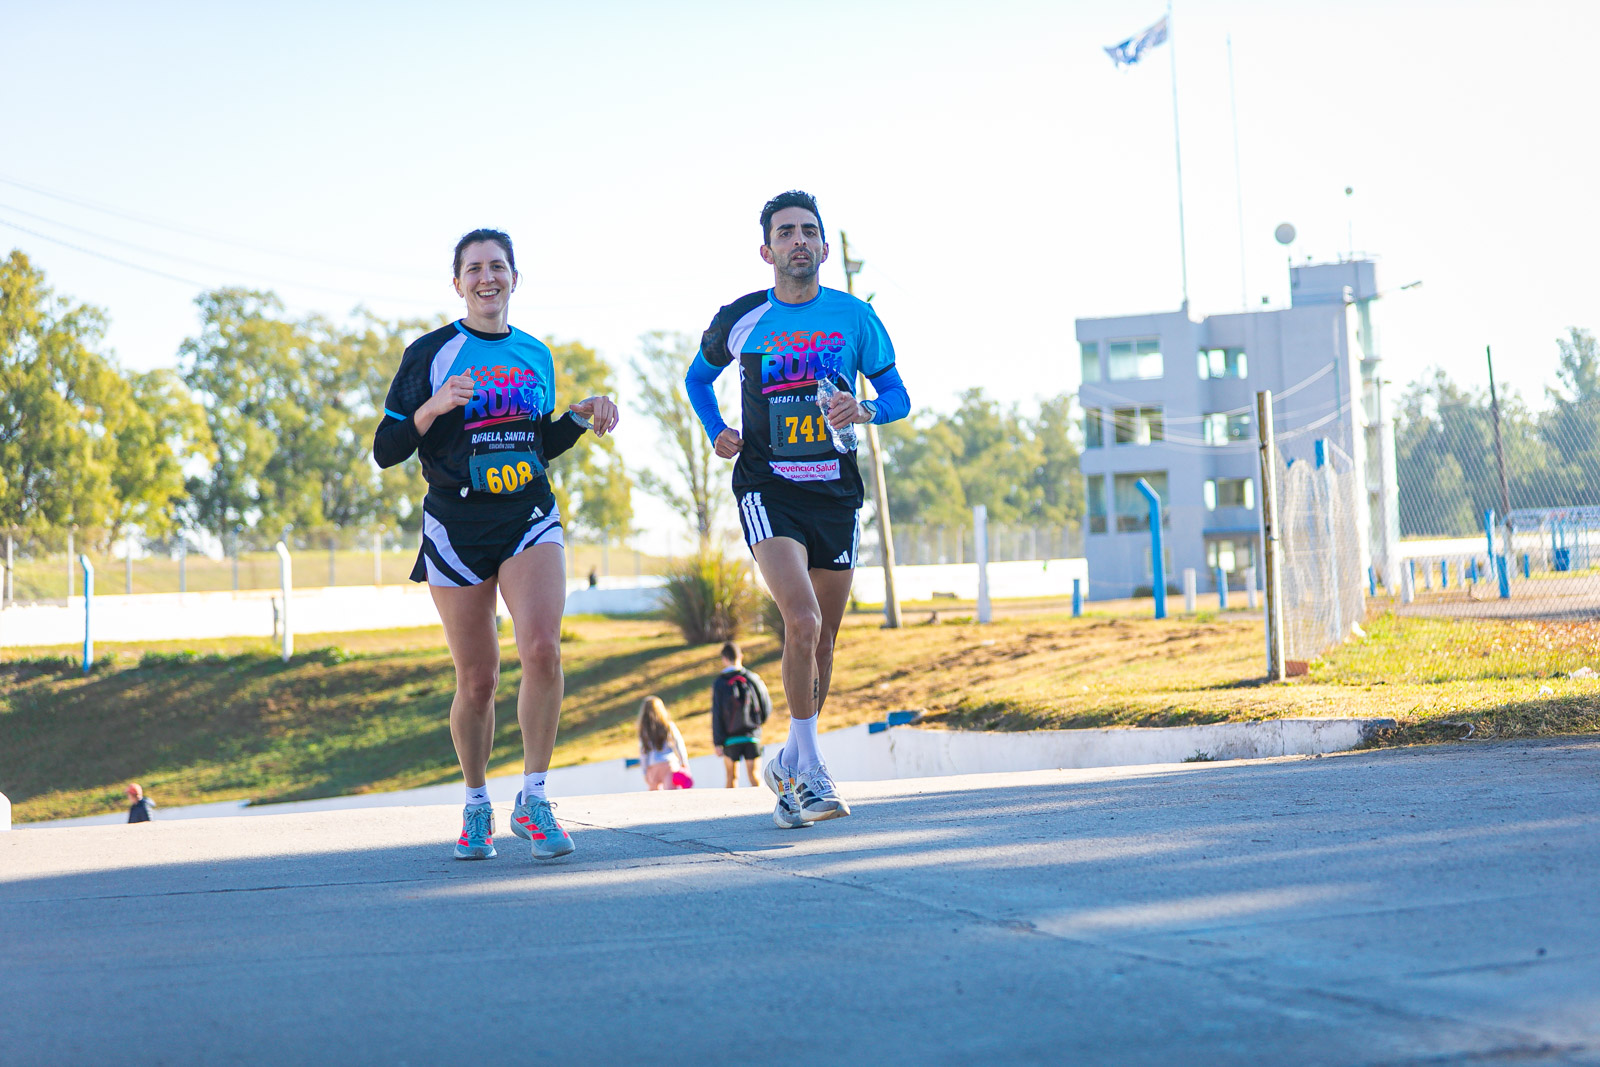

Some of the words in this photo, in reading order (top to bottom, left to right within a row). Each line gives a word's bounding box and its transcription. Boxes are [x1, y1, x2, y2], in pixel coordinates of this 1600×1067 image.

[762, 353, 836, 384] RUN
[464, 388, 532, 420] RUN
[504, 431, 525, 442] SANTA
[785, 415, 826, 444] 741
[487, 461, 533, 493] 608
[816, 462, 837, 473] Salud
